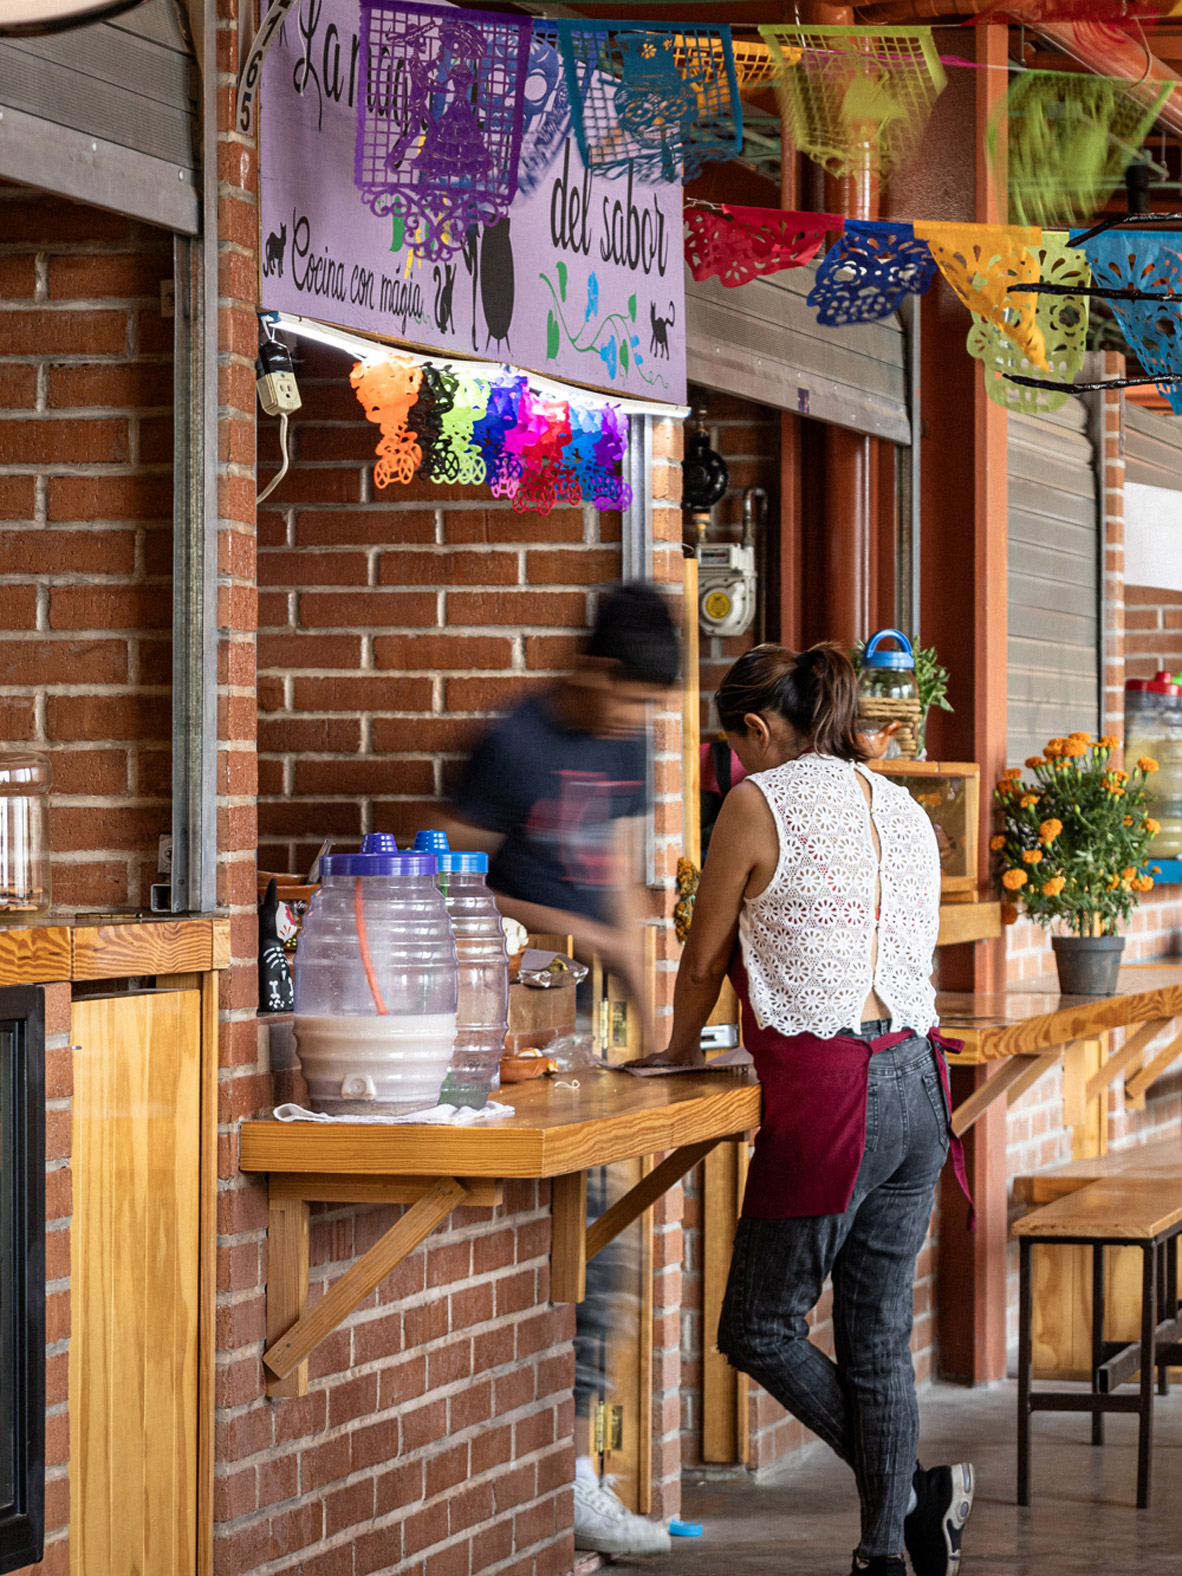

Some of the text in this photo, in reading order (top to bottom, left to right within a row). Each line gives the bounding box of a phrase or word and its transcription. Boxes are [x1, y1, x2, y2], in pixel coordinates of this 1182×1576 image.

[293, 0, 345, 134] La
[292, 206, 347, 303] Cocina
[350, 264, 375, 311] con
[550, 136, 669, 278] del sabor
